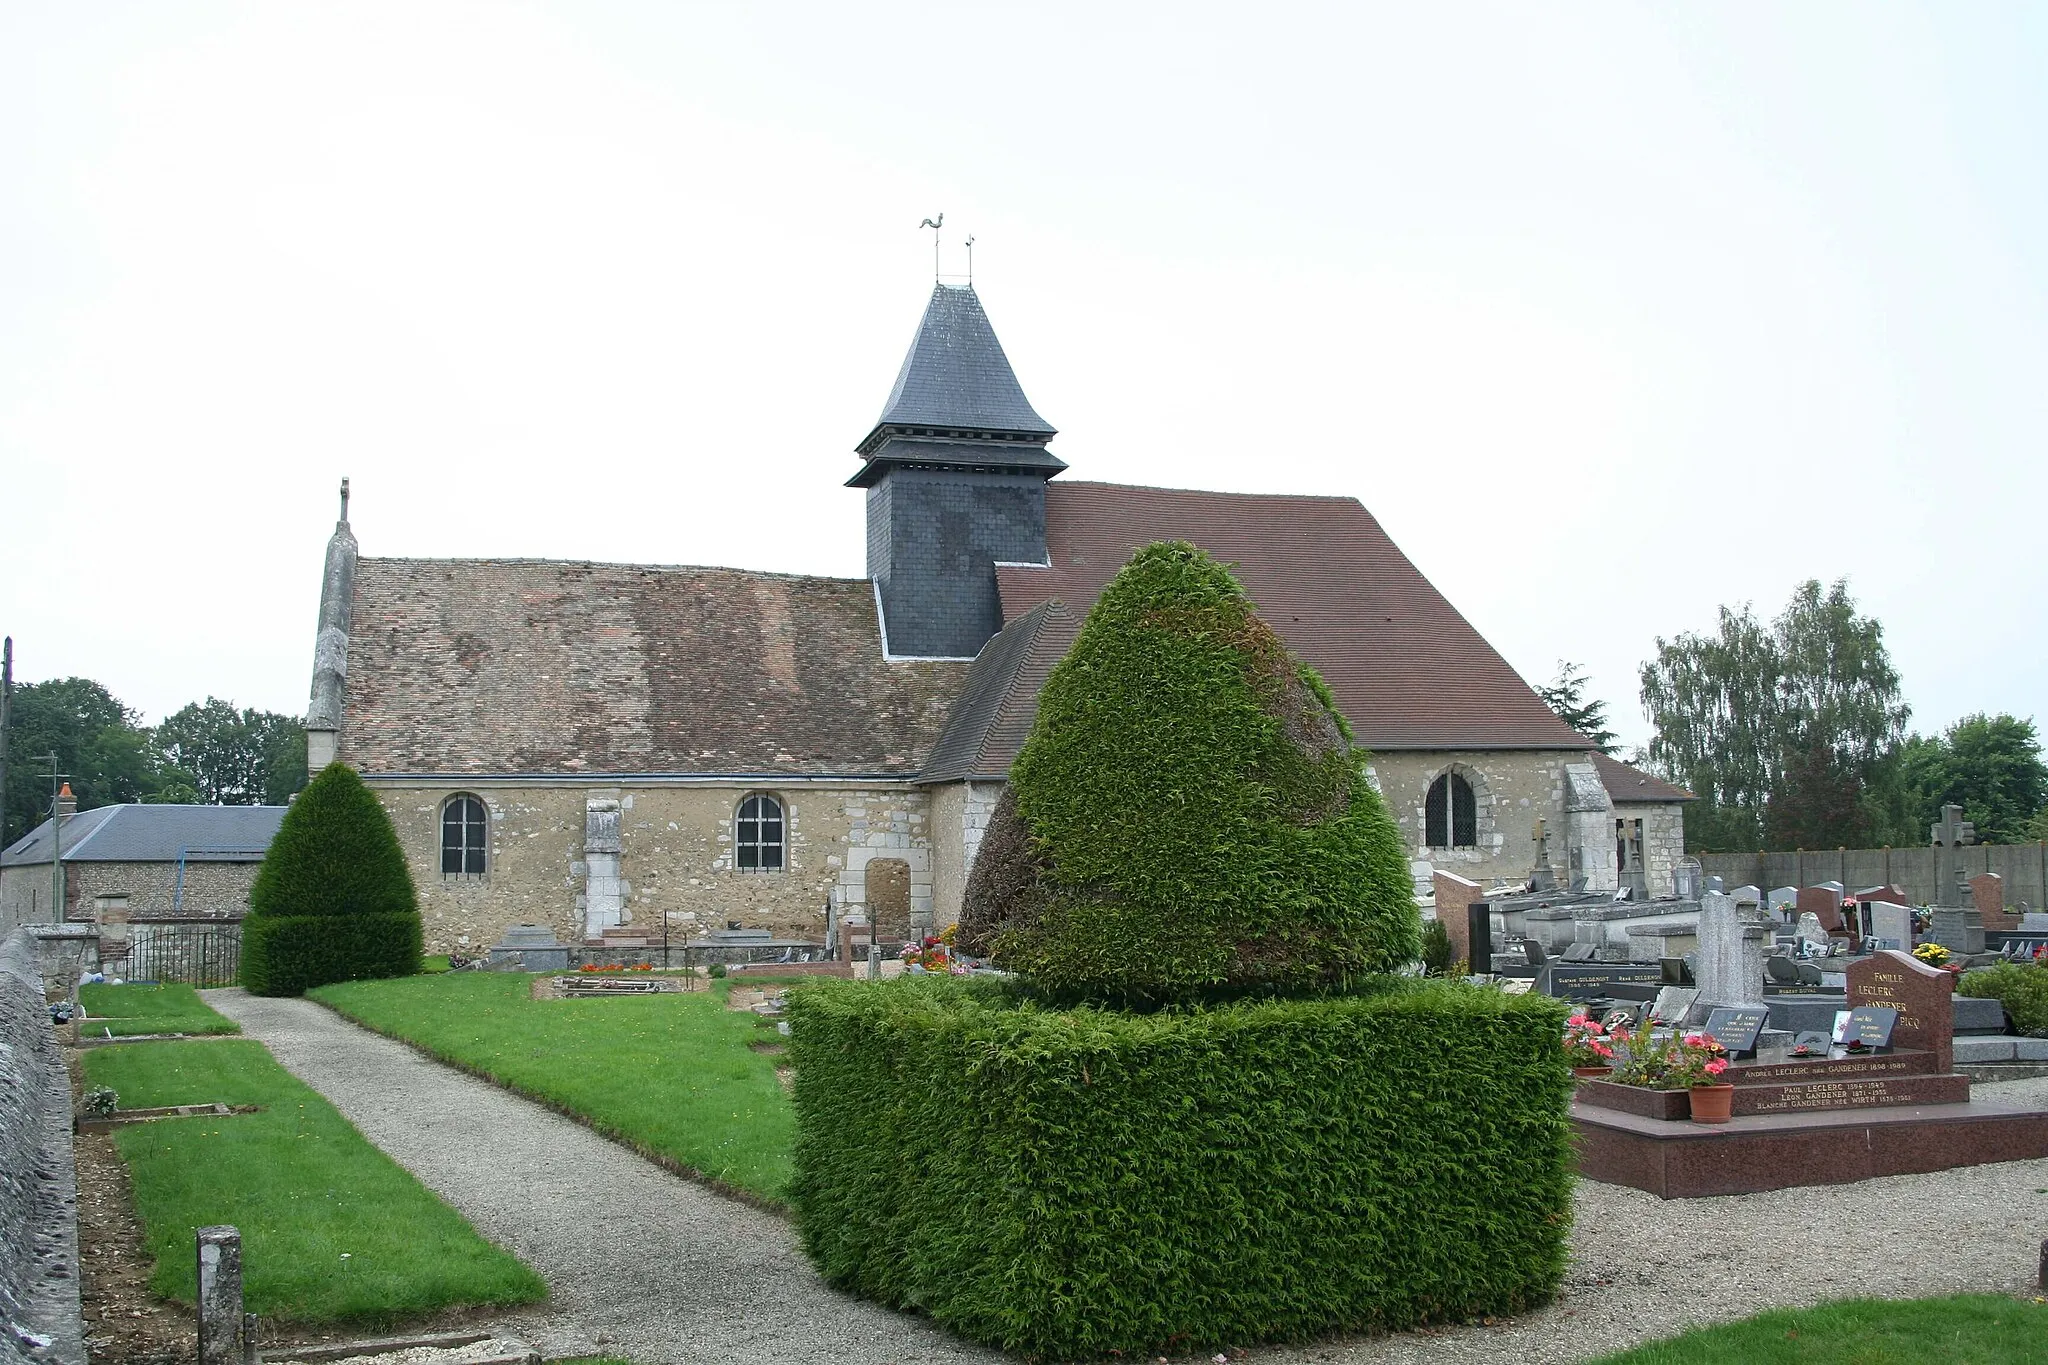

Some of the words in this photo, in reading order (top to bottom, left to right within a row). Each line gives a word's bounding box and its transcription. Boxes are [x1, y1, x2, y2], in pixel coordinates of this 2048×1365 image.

[1873, 972, 1903, 983] FAMILLE
[1858, 985, 1895, 997] LECLERC
[1900, 1016, 1920, 1030] PICQ
[1775, 1067, 1809, 1076] LECLERC
[1828, 1064, 1867, 1073] GANDENER
[1807, 1083, 1843, 1093] LECLERC
[1806, 1091, 1847, 1100] GANDENER
[1757, 1102, 1788, 1110] BLANCHE
[1791, 1098, 1831, 1108] GANDENER
[1851, 1096, 1876, 1104] WIRTH
